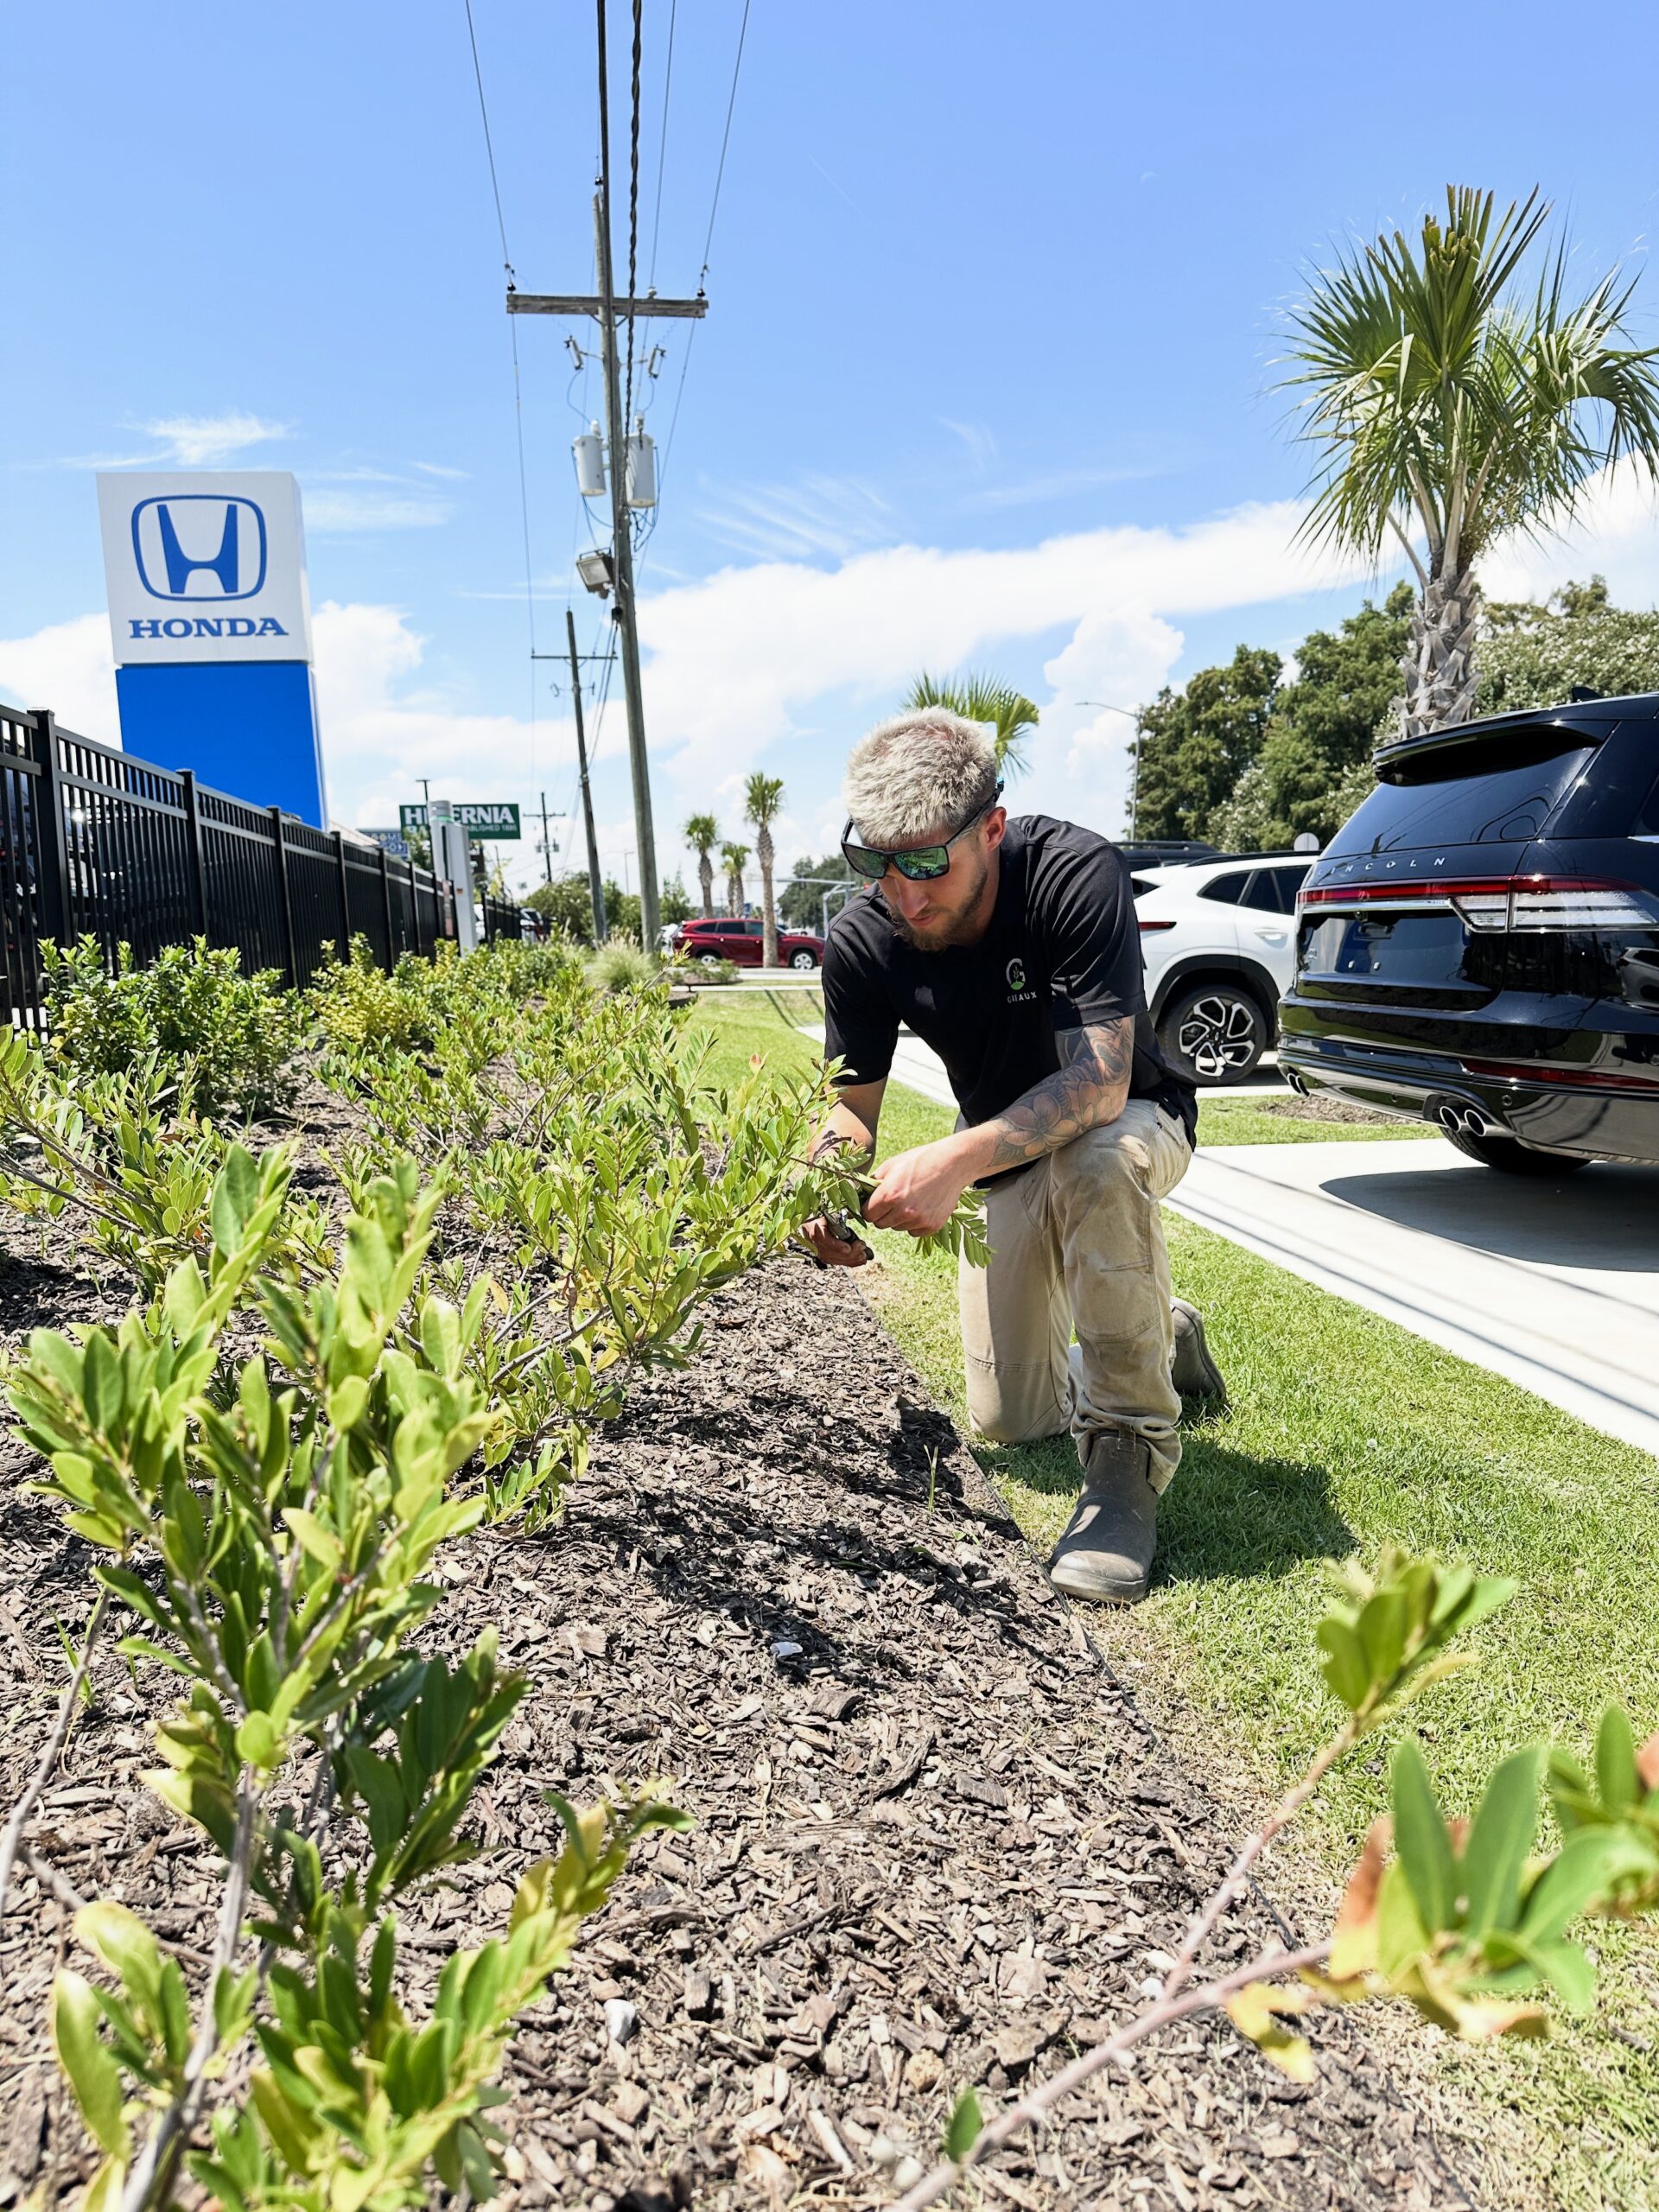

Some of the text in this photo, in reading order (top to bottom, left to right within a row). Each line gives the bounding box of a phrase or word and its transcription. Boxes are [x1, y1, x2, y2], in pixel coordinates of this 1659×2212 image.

[128, 617, 289, 639] HONDA
[404, 806, 515, 824] HIERNIA
[1318, 857, 1446, 875] LINCOLN
